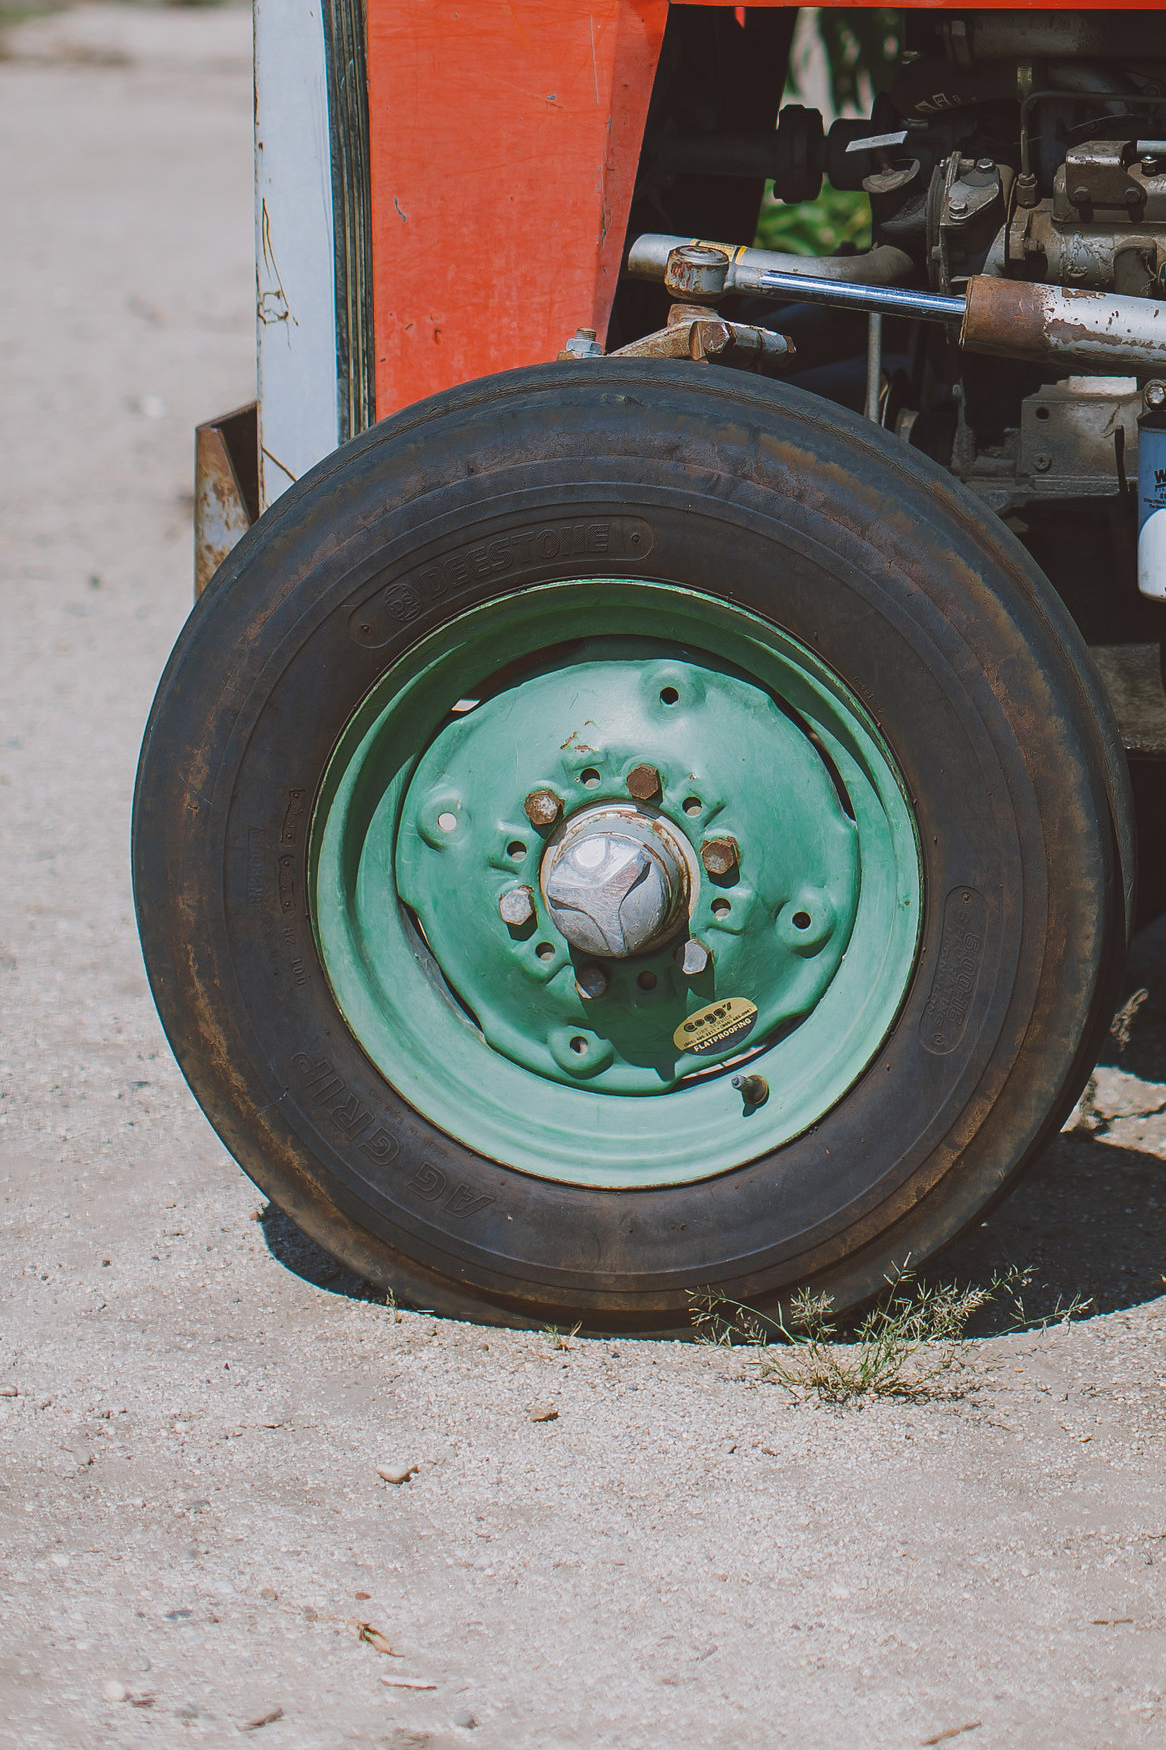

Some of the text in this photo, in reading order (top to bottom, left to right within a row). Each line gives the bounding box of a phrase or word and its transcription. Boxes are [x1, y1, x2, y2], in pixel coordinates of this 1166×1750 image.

[419, 523, 611, 601] DEESTONE
[949, 933, 980, 1025] 6.00-16
[693, 1018, 751, 1052] FLATPROOFING
[291, 1051, 400, 1166] GRIP
[407, 1161, 498, 1219] AG
